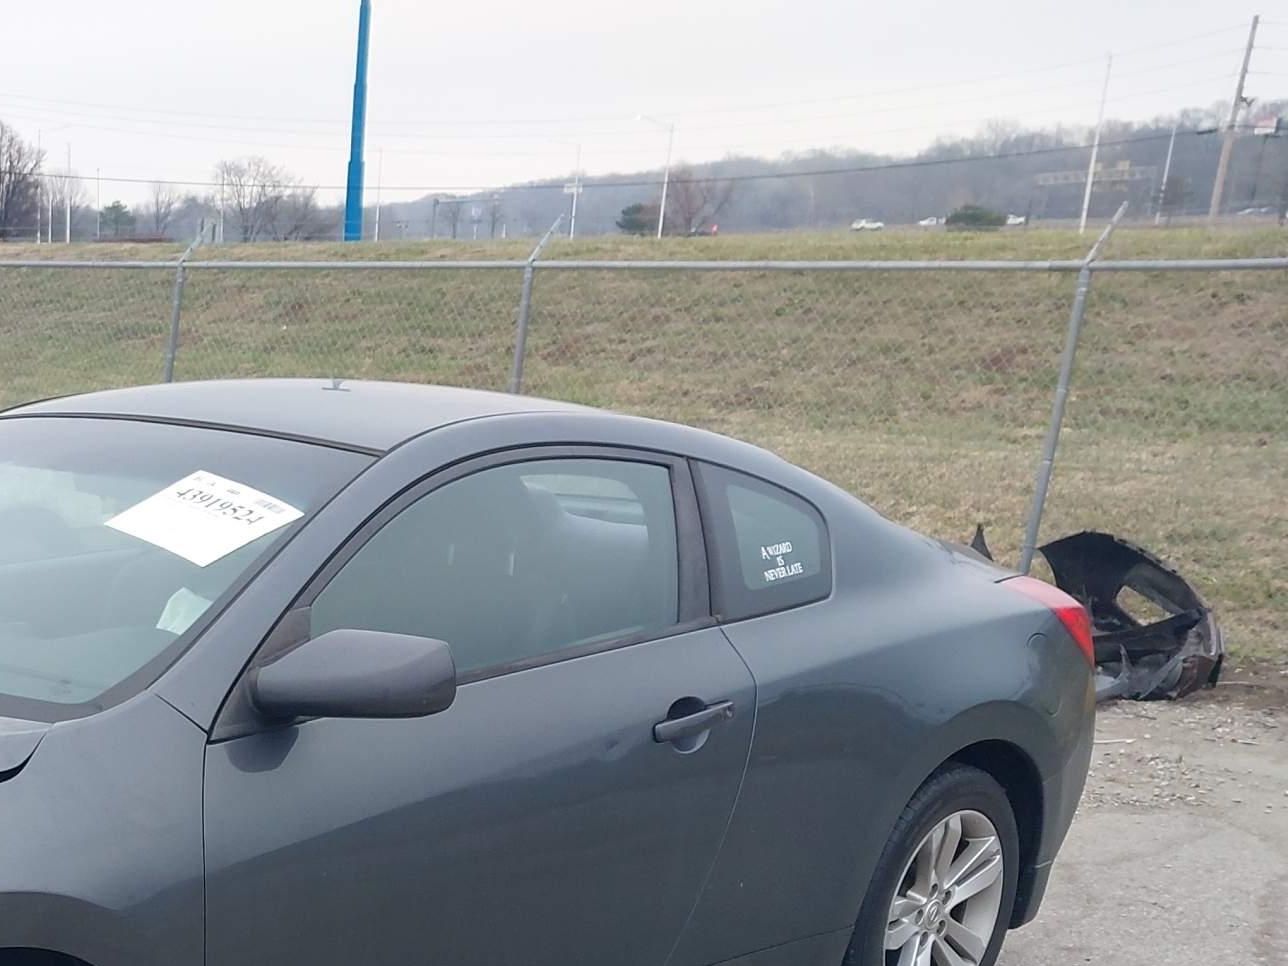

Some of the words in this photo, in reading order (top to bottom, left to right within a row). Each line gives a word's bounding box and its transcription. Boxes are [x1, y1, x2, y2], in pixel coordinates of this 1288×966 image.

[176, 488, 264, 525] 43919524
[761, 546, 771, 560] A
[767, 541, 793, 556] WIZARD
[776, 555, 785, 566] IS
[764, 567, 787, 582] NEVER
[786, 562, 804, 577] LATE
